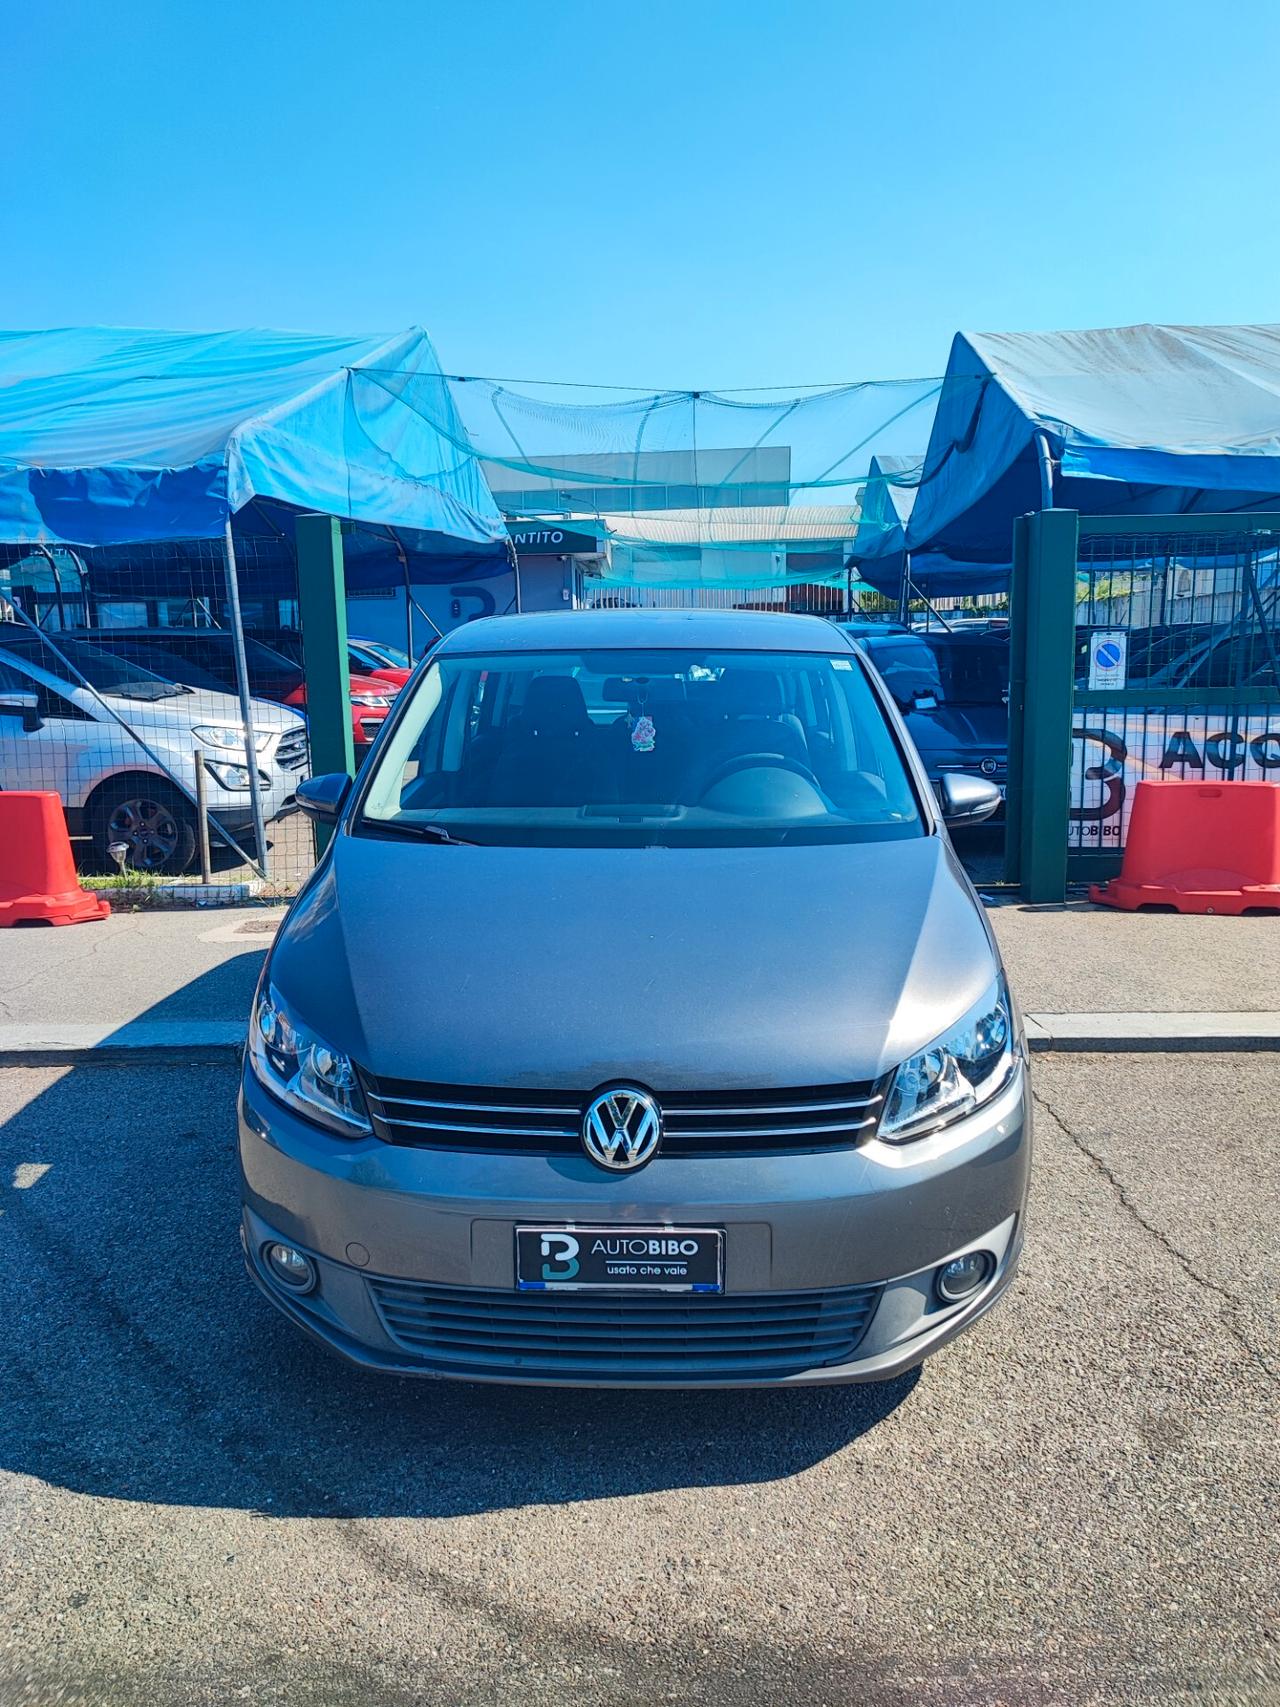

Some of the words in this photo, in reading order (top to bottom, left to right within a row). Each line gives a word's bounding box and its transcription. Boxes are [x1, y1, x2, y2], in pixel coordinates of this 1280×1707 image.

[591, 1239, 699, 1256] AUTOBIBO
[607, 1265, 638, 1275] usato
[640, 1265, 661, 1275] che
[664, 1265, 688, 1276] vale
